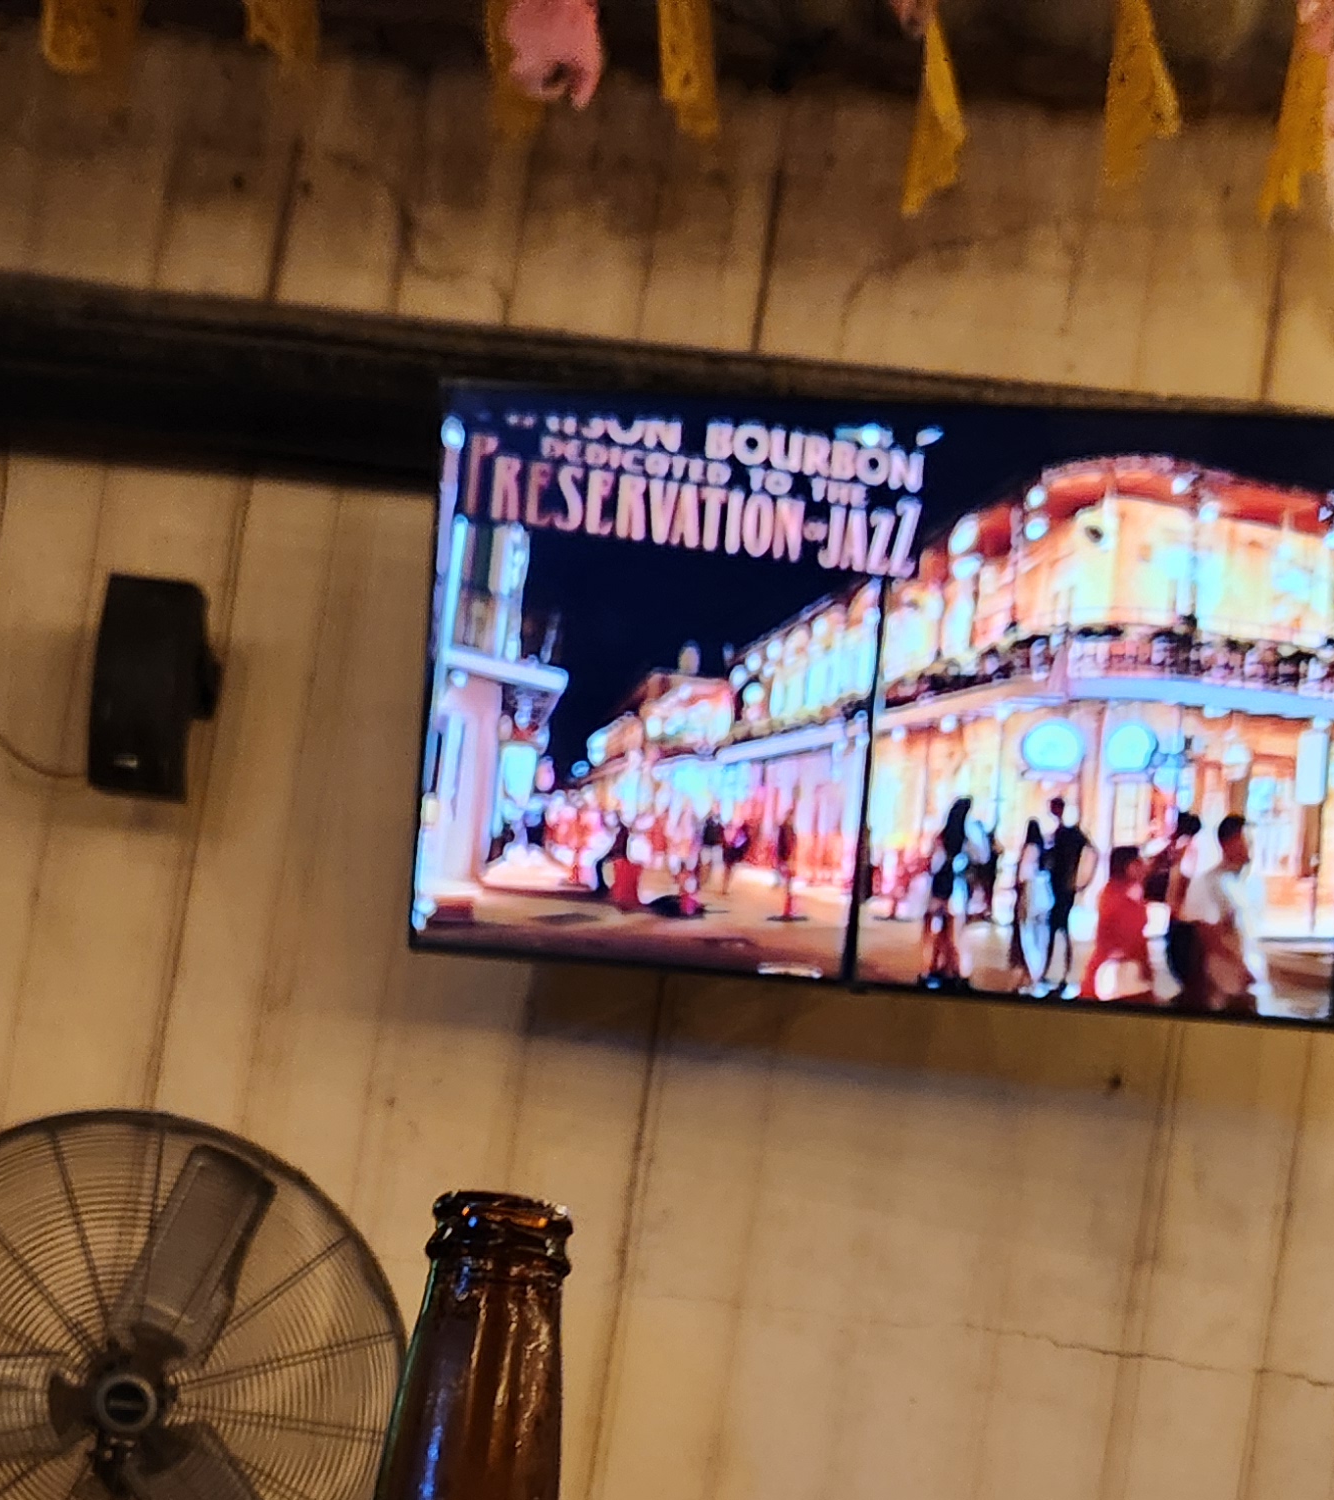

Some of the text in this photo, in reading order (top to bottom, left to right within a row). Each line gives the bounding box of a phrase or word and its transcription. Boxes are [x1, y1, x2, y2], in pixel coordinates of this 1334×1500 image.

[705, 415, 925, 494] BOURBON
[749, 466, 794, 497] TO
[467, 431, 807, 562] PRESERVATION
[817, 496, 923, 579] JAZZ
